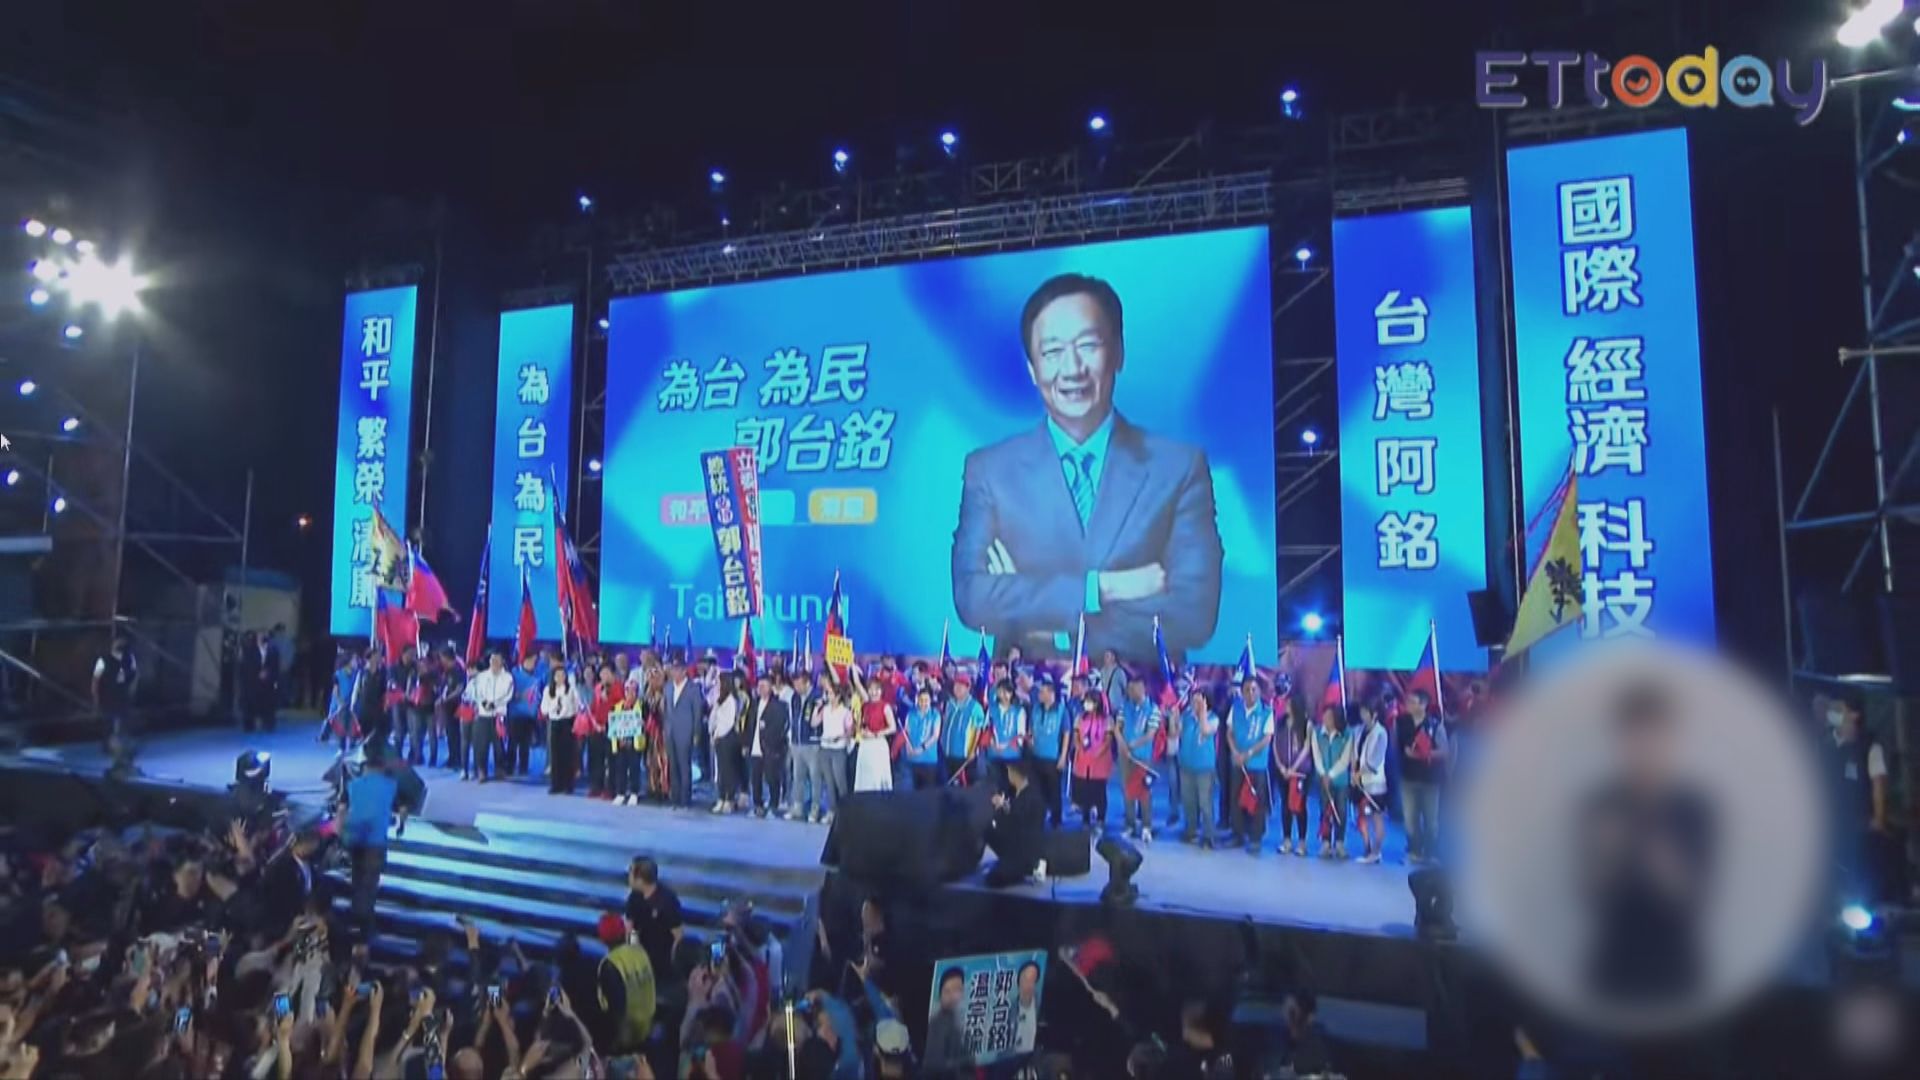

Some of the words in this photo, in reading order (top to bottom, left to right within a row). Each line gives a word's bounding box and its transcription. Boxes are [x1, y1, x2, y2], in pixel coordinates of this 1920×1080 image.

[1559, 175, 1641, 315] 國際
[360, 317, 392, 401] 和平
[658, 357, 746, 412] 為台
[760, 342, 869, 407] 為民
[1566, 337, 1648, 477] 經濟
[356, 415, 388, 514] 繁榮
[514, 364, 549, 567] 為台為民
[735, 410, 896, 474] 郭台銘
[1374, 290, 1438, 569] 台灣阿銘
[1577, 499, 1656, 640] 科技
